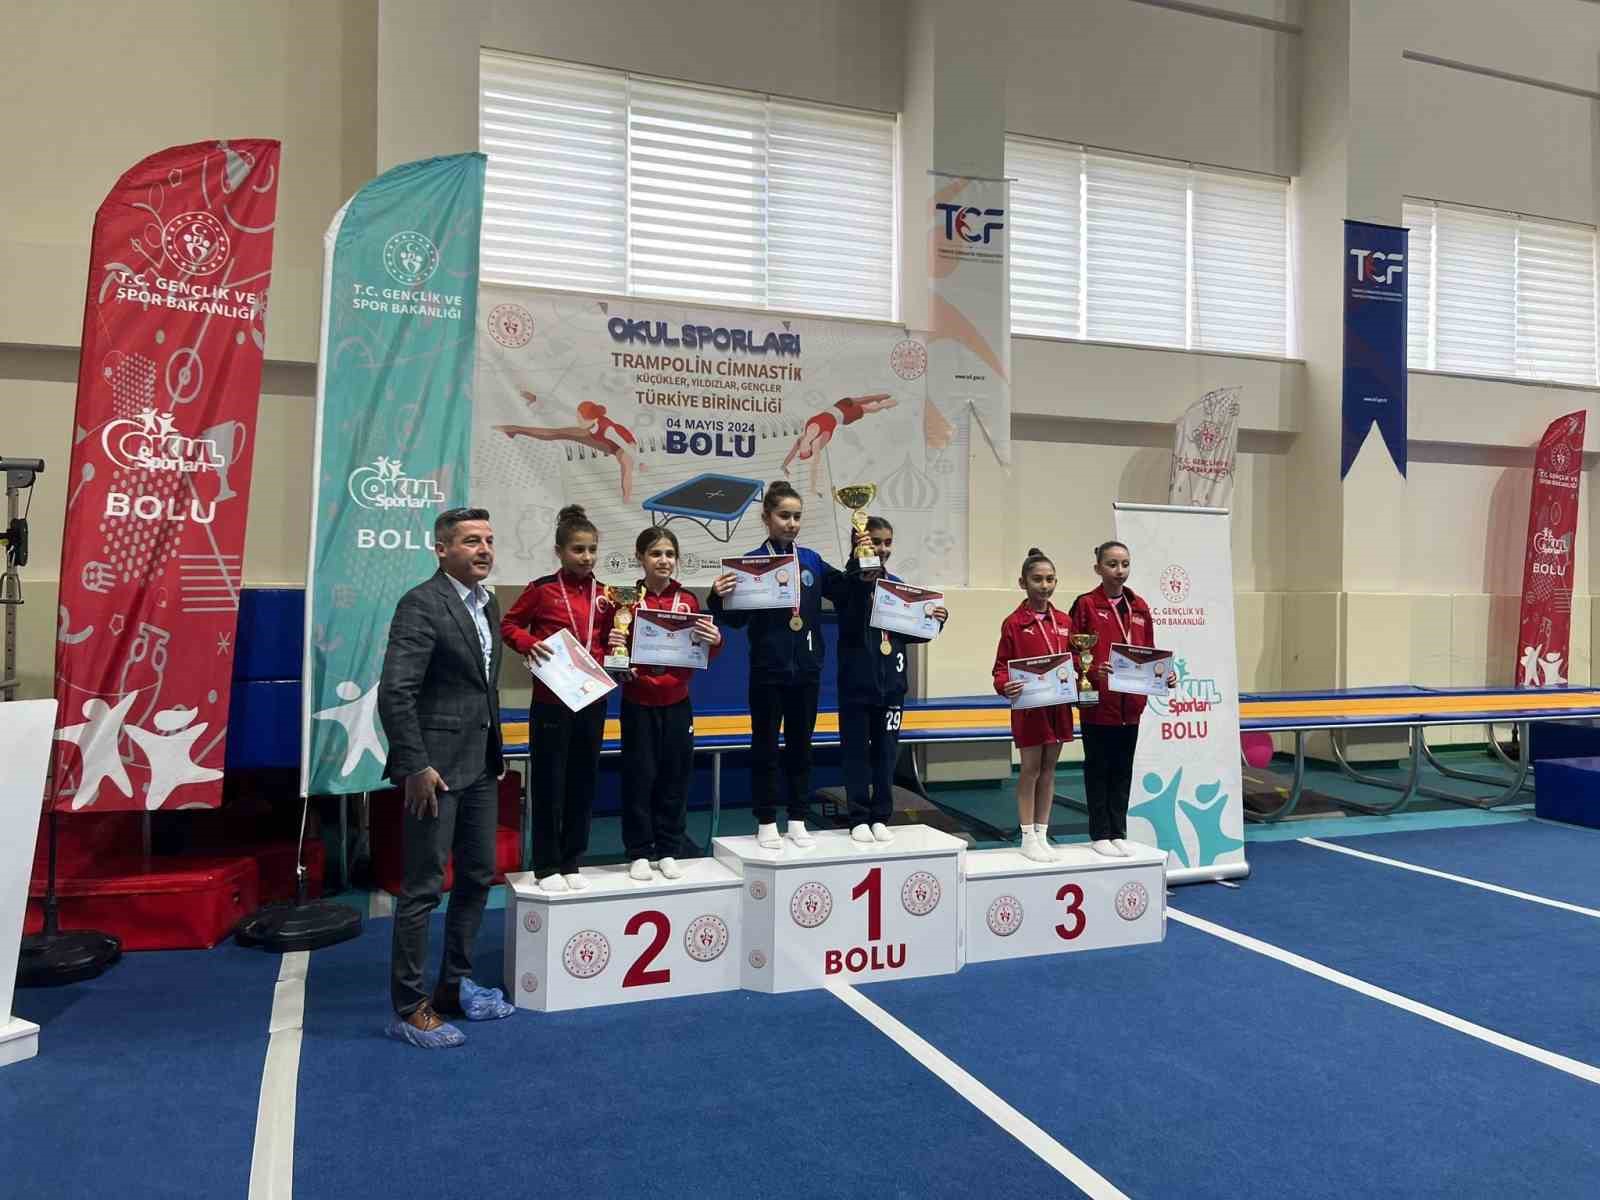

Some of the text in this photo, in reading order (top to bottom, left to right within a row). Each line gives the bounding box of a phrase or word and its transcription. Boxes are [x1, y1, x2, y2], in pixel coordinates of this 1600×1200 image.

[935, 203, 1004, 244] TCF
[1350, 248, 1404, 285] TCF
[119, 271, 257, 305] T.C. GENÇLİK VE
[353, 283, 378, 297] T.C.
[444, 295, 463, 306] VE
[116, 287, 255, 321] SPOR BAKANLIĞI
[352, 298, 461, 320] SPOR BAKANLIĞI
[607, 316, 680, 348] OKUL
[611, 351, 712, 375] TRAMPOLİN
[636, 373, 689, 387] KÜÇÜKLER,
[741, 382, 782, 394] GENÇLER
[635, 388, 783, 414] TÜRKİYE BİRİNCİLİĞİ
[666, 418, 756, 433] 04 MAYIS 2024
[666, 430, 756, 459] BOLU
[106, 492, 217, 524] BOLU
[1532, 562, 1566, 576] BOLU
[1152, 617, 1167, 626] POR
[1195, 607, 1204, 616] VE
[806, 629, 814, 651] 1
[895, 652, 904, 673] 3
[886, 711, 901, 730] 29
[1160, 721, 1208, 740] BOLU
[851, 867, 882, 942] 1
[1055, 883, 1086, 940] 3
[622, 909, 672, 988] 2
[825, 943, 907, 975] BOLU
